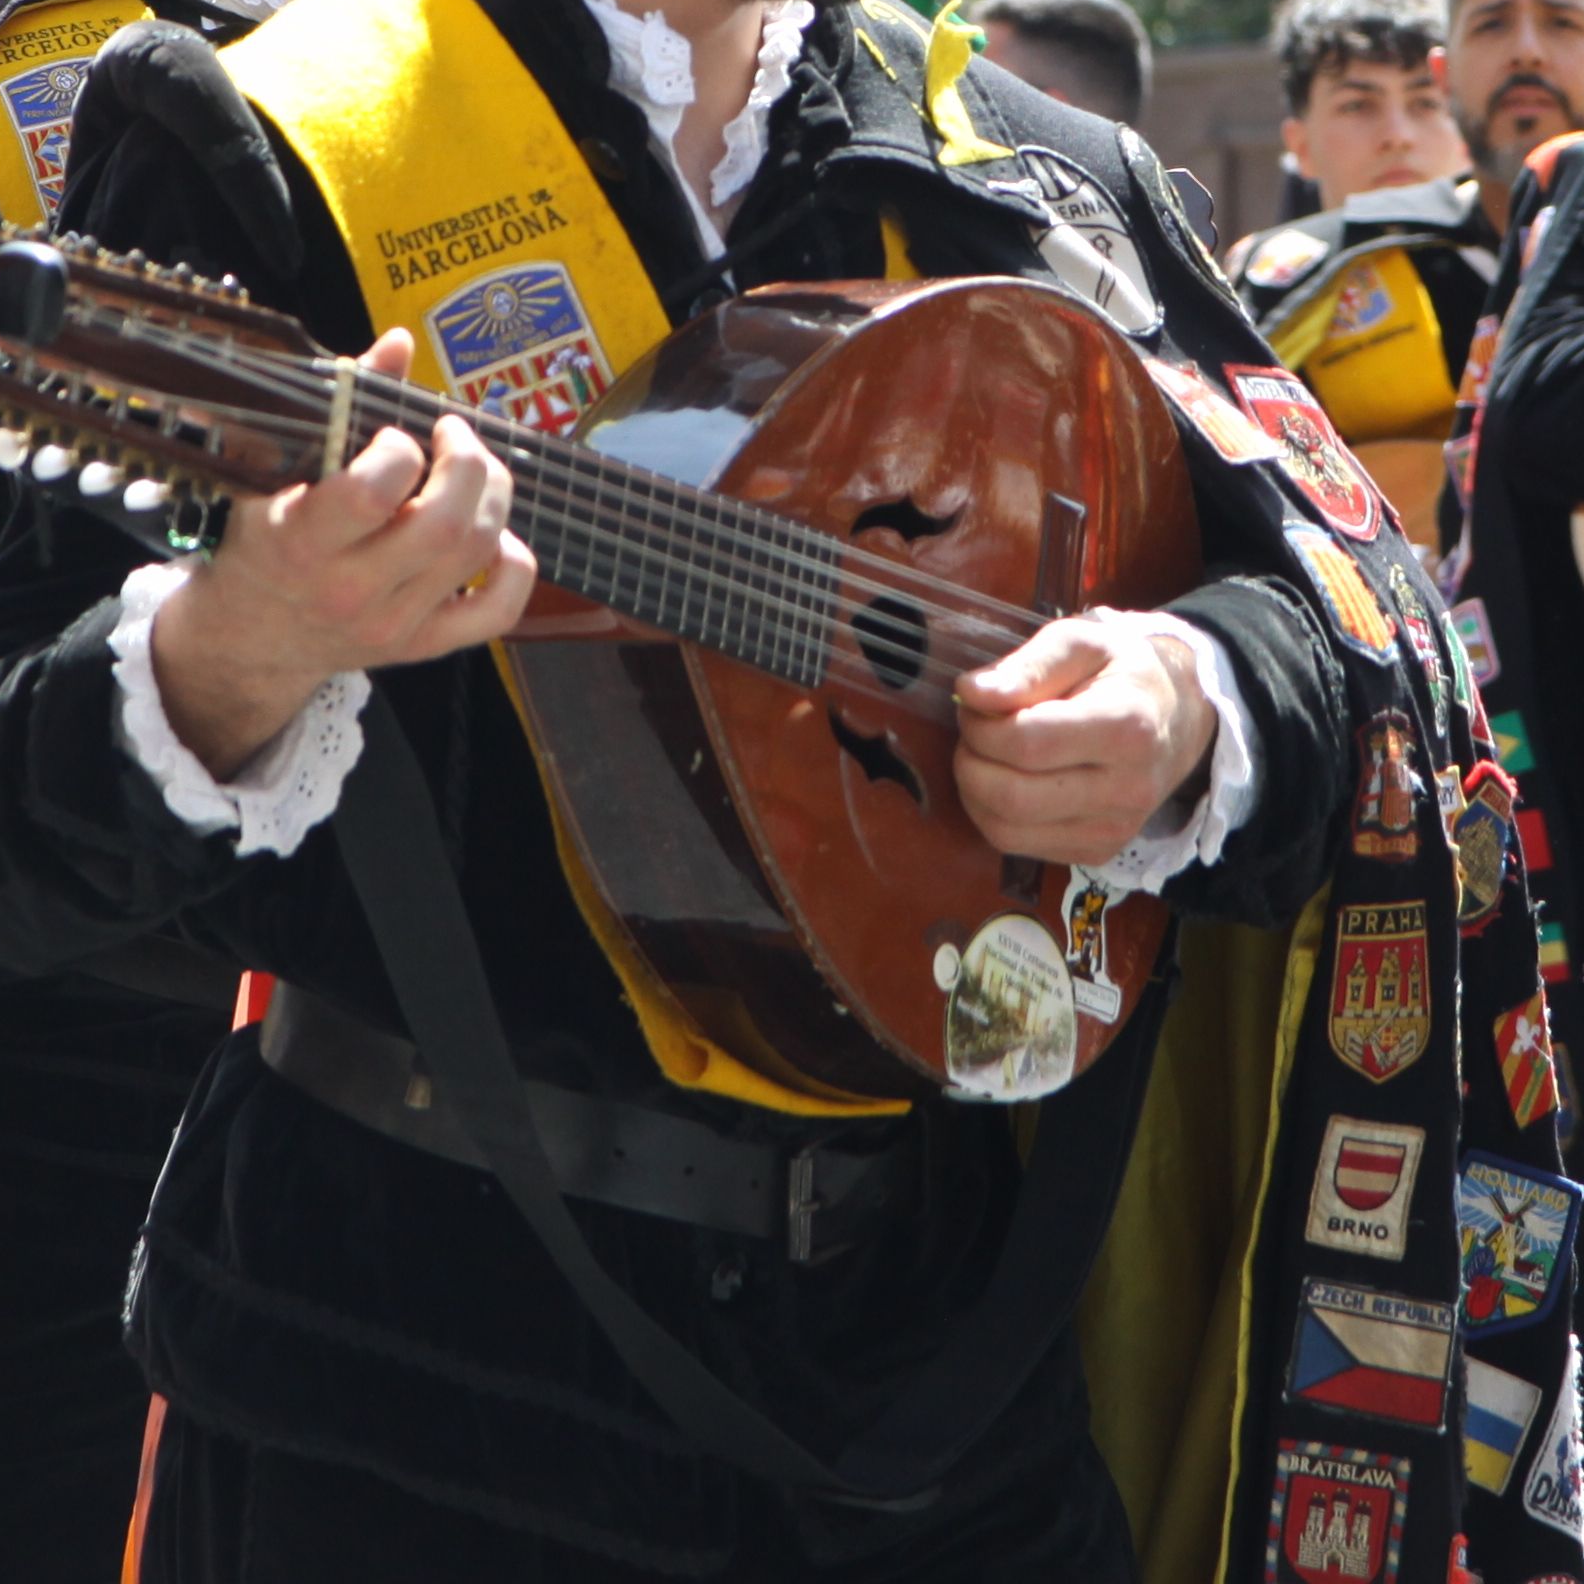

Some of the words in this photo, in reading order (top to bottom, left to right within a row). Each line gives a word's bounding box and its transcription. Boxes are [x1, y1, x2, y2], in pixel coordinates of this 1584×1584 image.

[1058, 199, 1109, 222] ERNA
[386, 206, 569, 291] BARCELONA
[1347, 907, 1425, 934] PRAHA
[1466, 1163, 1570, 1213] HOLLAND
[1327, 1216, 1389, 1241] BRNO
[1308, 1283, 1366, 1311] CZECH
[1372, 1293, 1454, 1328] REPUBLIC
[1288, 1453, 1399, 1490] BRATISLAVA
